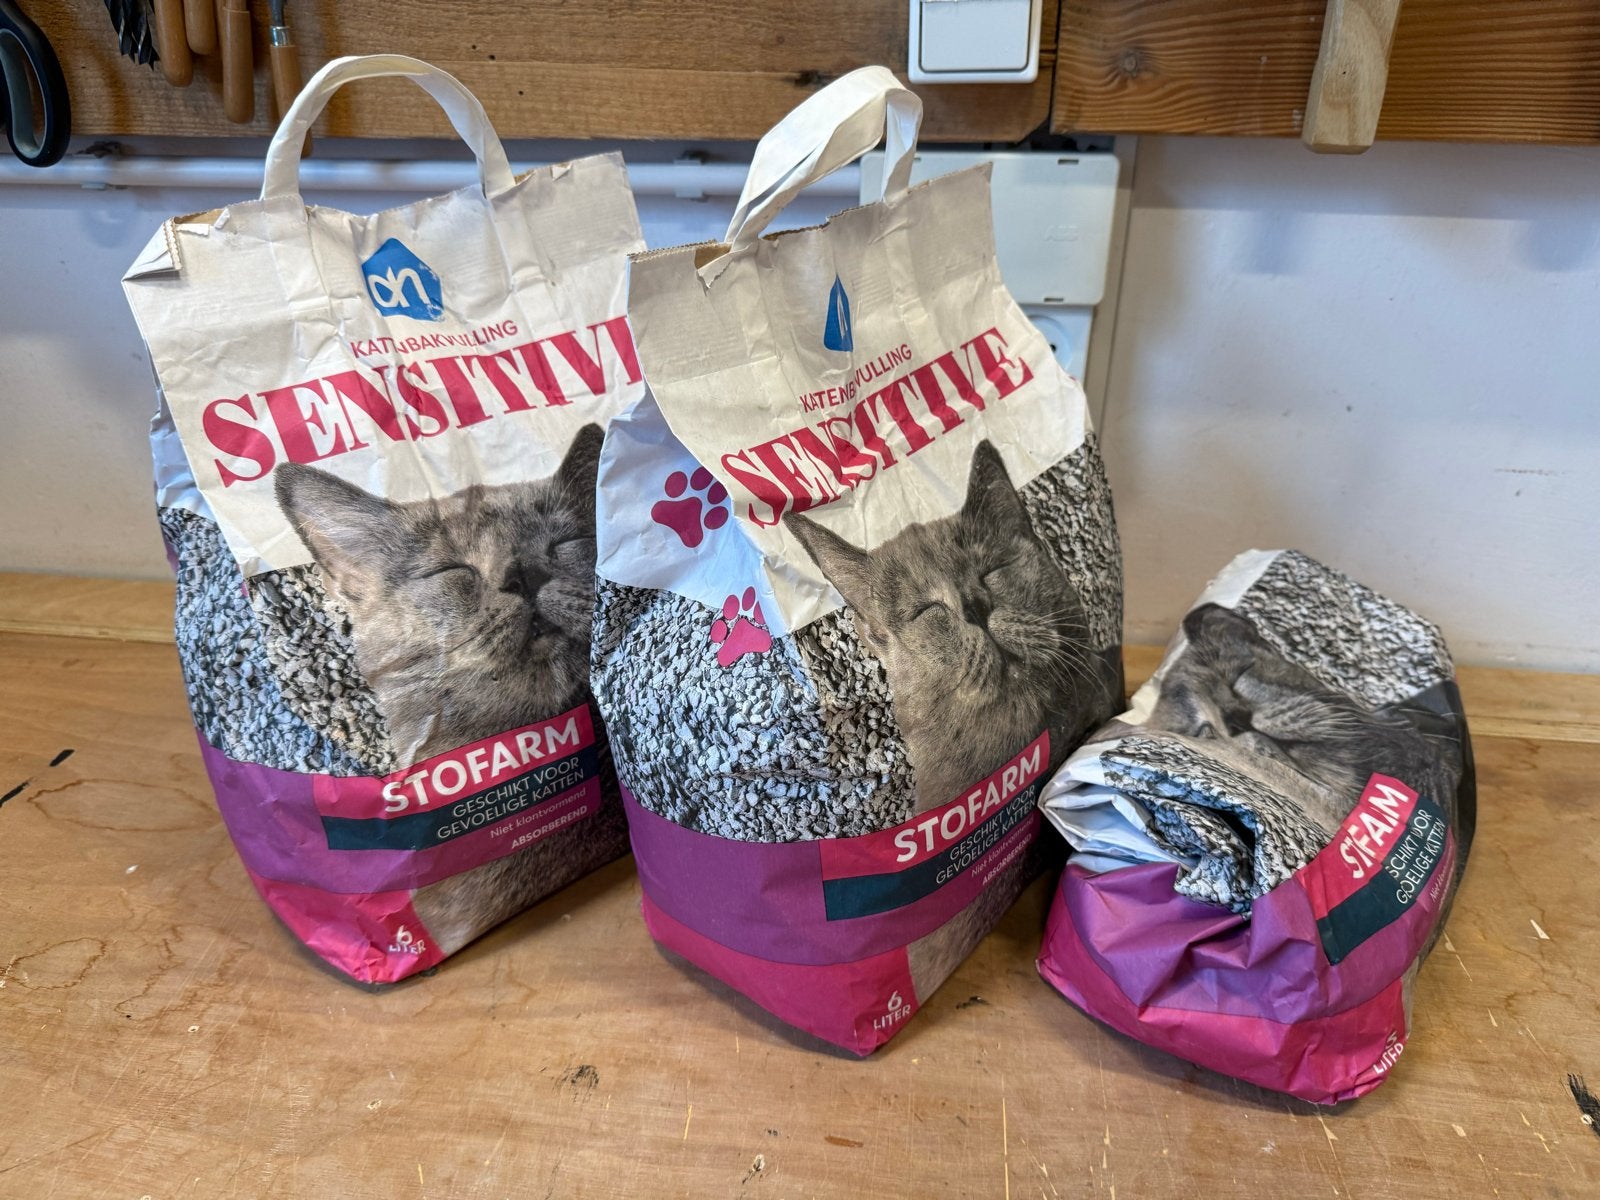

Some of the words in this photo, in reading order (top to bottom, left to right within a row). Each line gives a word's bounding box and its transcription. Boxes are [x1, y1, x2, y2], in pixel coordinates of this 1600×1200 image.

[720, 326, 1035, 529] SENSITIVE
[381, 716, 580, 813] STOFARM
[452, 775, 530, 818] GESCHIKT
[533, 756, 580, 785] VOOR
[437, 794, 529, 839] GEVOELIGE
[532, 768, 584, 802] KATTEN
[490, 822, 514, 839] Niet
[516, 787, 587, 828] klontvormend
[511, 804, 588, 849] ABSORBEREND
[894, 743, 1041, 863] STOFARM
[950, 810, 1004, 861] GESCHIKT
[1006, 784, 1035, 815] VOOR
[935, 829, 1000, 885] GEVOELIGE
[1002, 795, 1036, 834] KATTEN
[388, 939, 427, 955] LITER
[396, 924, 413, 945] 6
[873, 1004, 911, 1030] LITER
[887, 990, 903, 1012] 6
